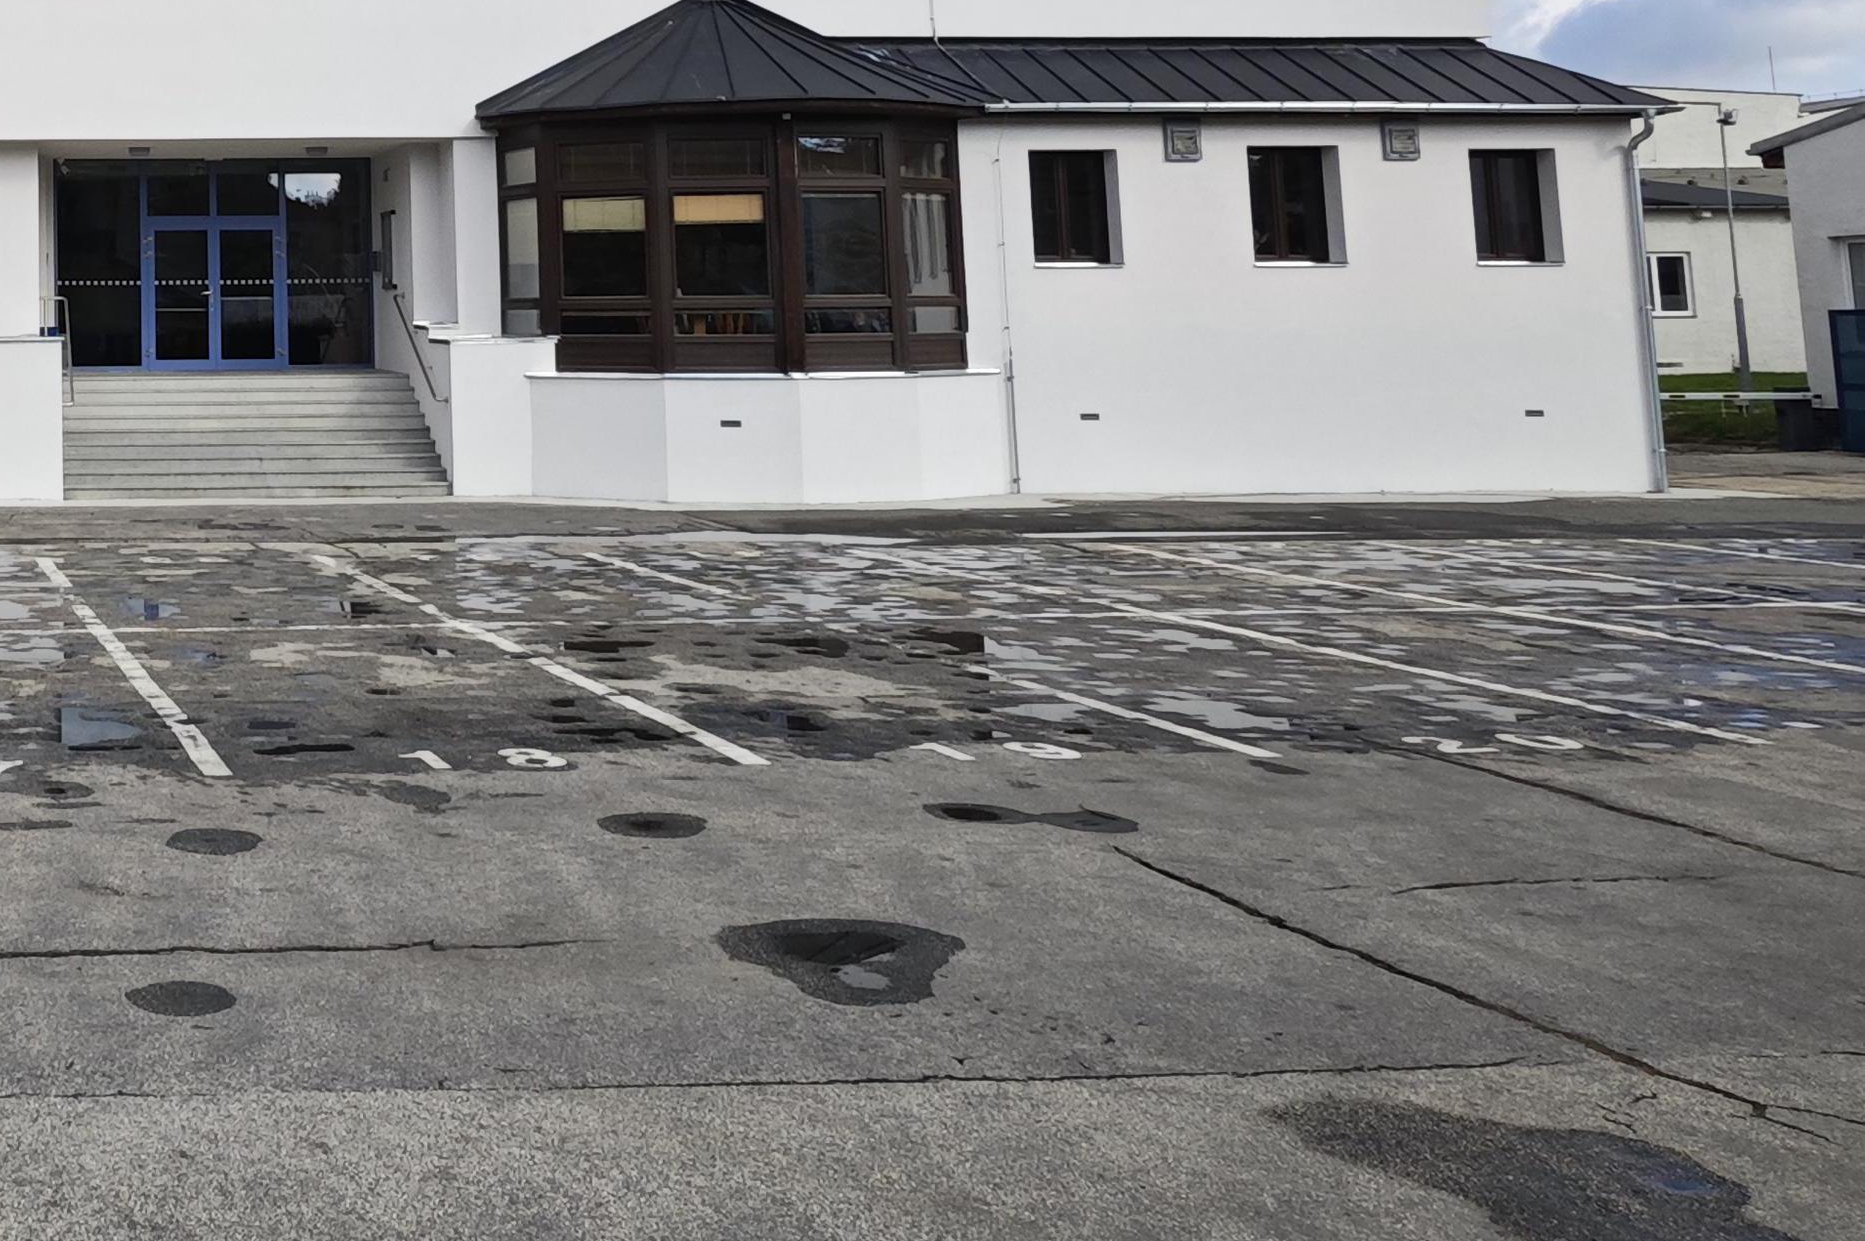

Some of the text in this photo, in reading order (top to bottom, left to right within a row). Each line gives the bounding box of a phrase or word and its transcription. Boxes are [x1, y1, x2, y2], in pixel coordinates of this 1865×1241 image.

[909, 741, 1083, 761] 19
[1401, 733, 1584, 754] 20
[398, 747, 568, 769] 18
